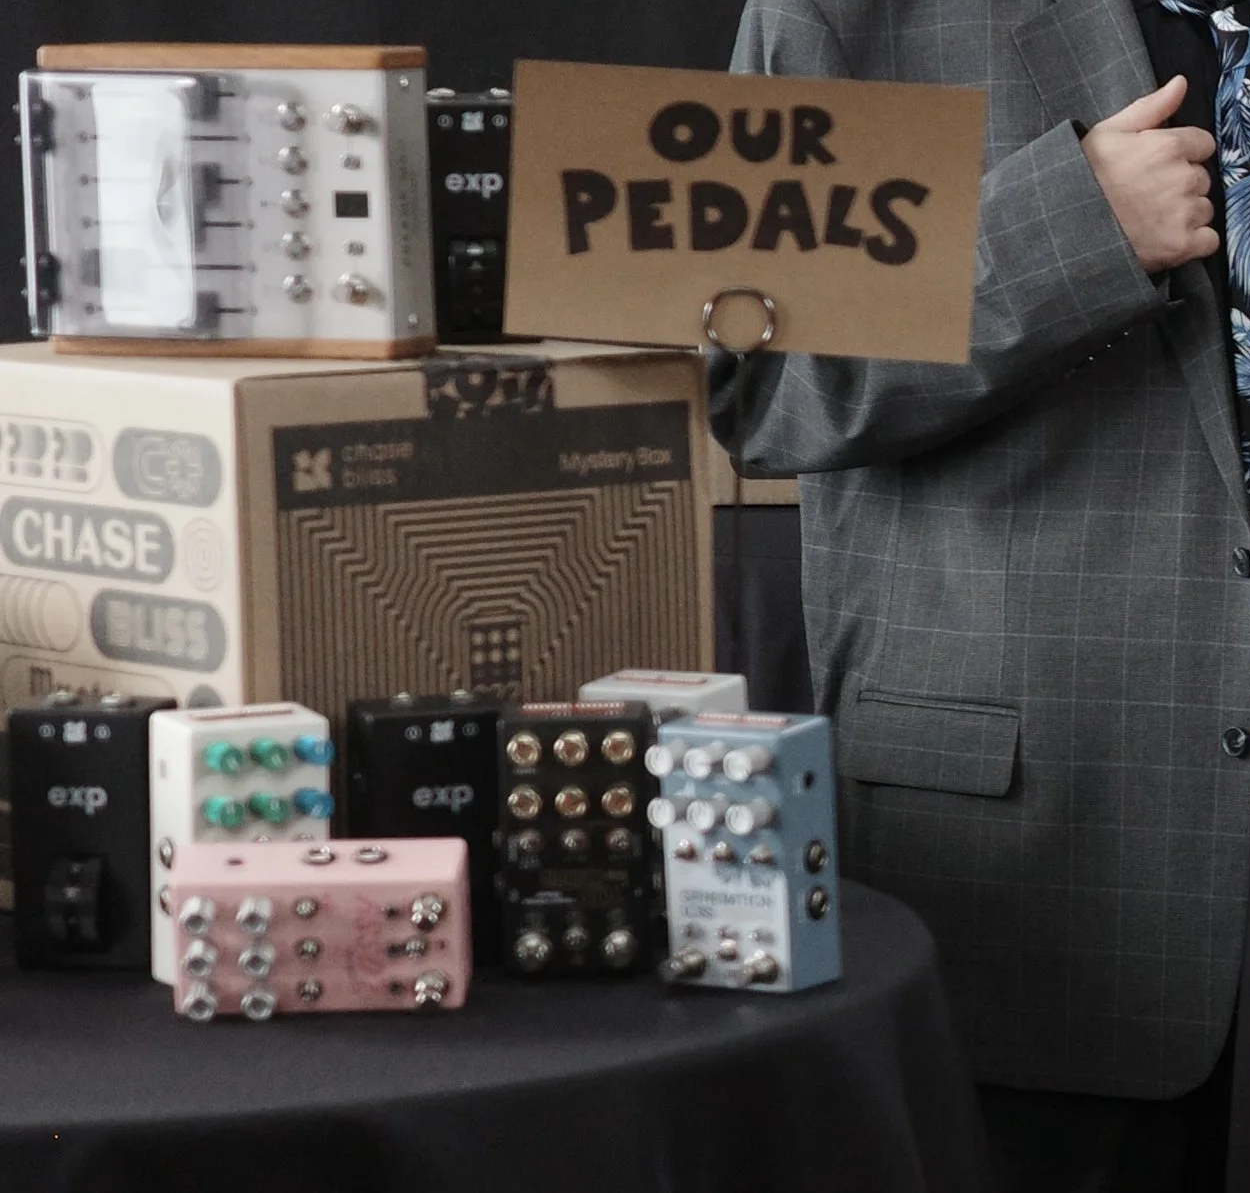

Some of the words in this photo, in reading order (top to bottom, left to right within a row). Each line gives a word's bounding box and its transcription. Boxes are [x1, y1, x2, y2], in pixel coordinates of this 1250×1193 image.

[648, 100, 837, 166] OUR
[444, 172, 504, 200] exp
[561, 168, 931, 266] PEDALS
[559, 450, 636, 476] Mystery
[637, 447, 673, 467] Box
[12, 508, 163, 575] CHASE
[47, 785, 109, 816] exp
[411, 784, 475, 813] exp
